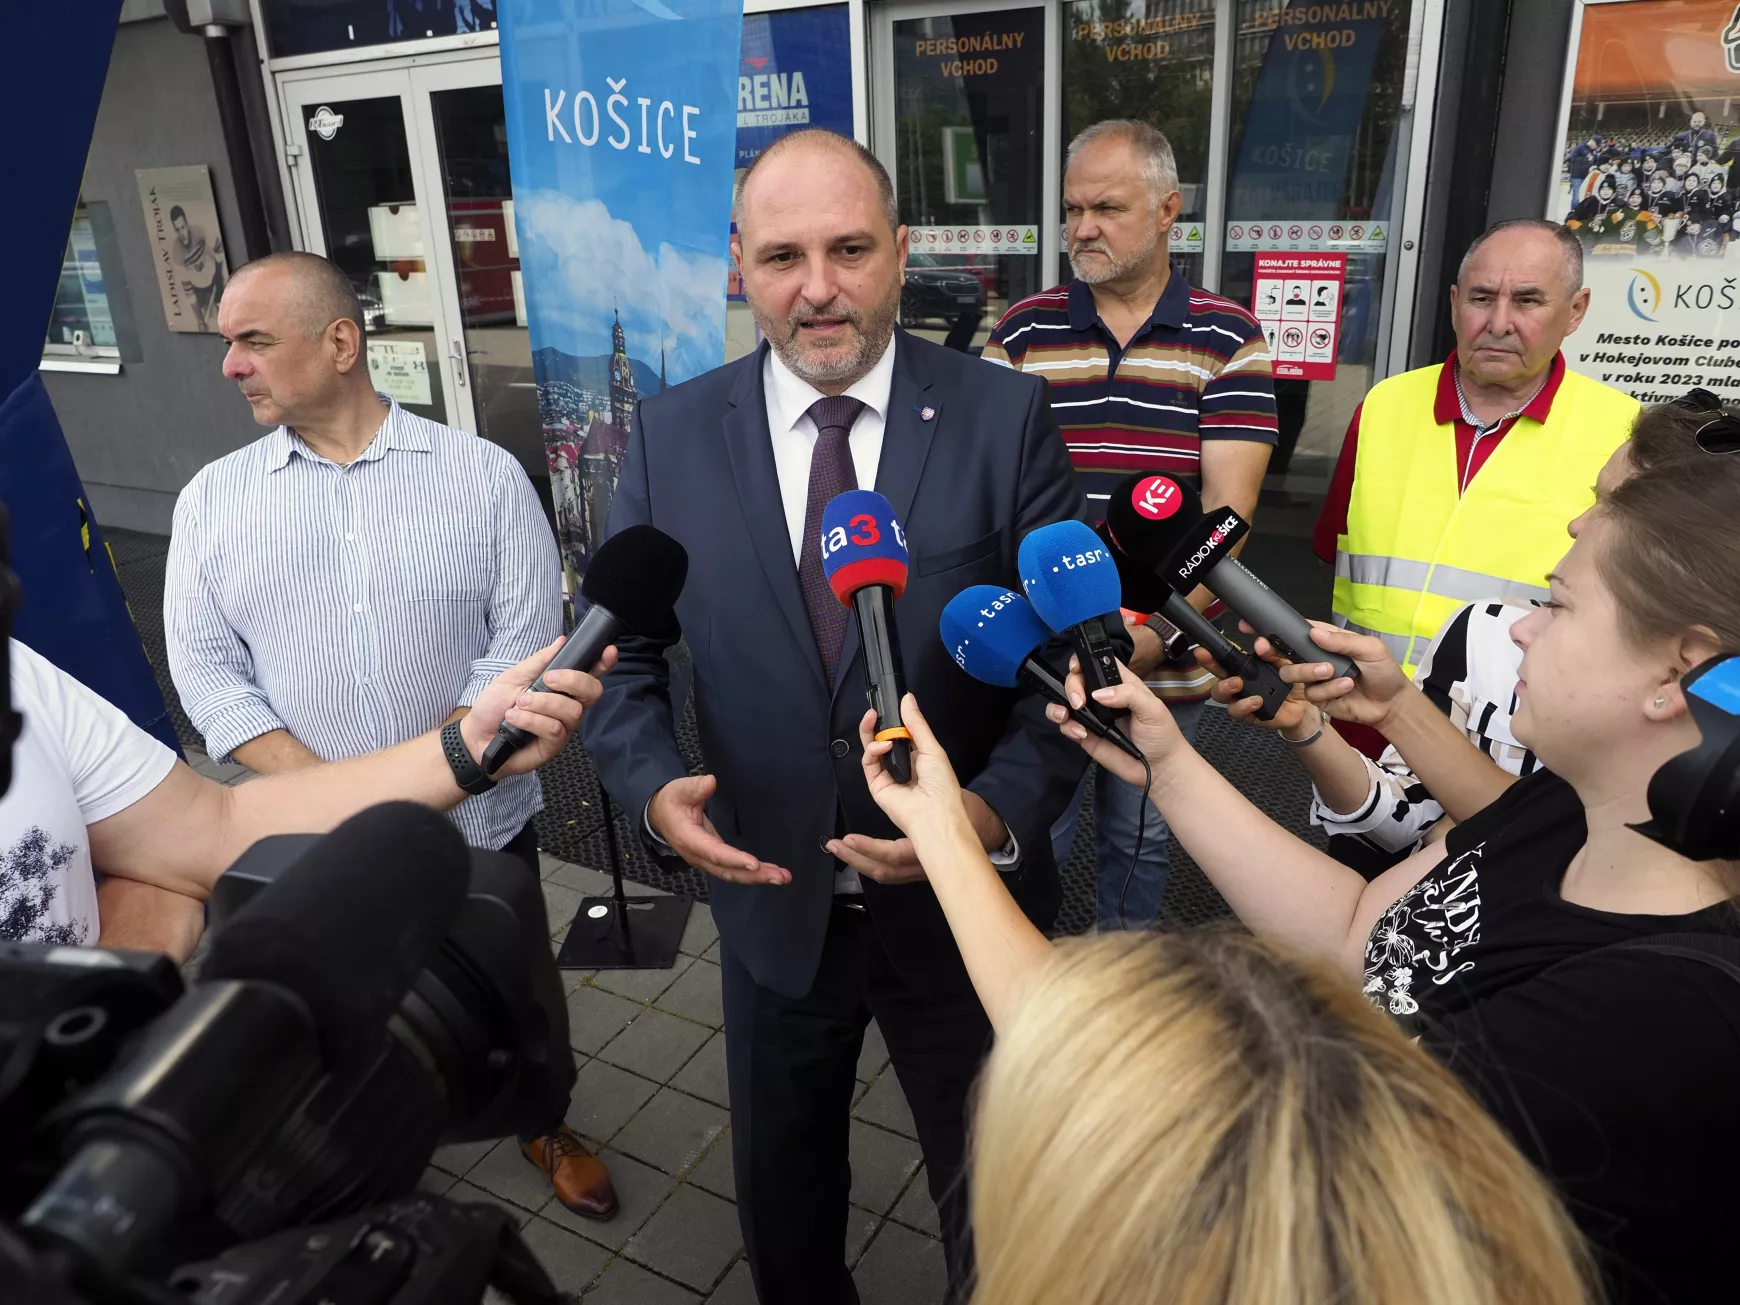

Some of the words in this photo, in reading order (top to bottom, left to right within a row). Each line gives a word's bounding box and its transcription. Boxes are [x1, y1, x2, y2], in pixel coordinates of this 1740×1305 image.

[1077, 13, 1200, 40] PERSONÁLNY
[1254, 0, 1393, 29] PERSONÁLNY
[916, 31, 1025, 56] PERSONÁLNY
[1106, 41, 1170, 62] VCHOD
[1284, 29, 1356, 51] VCHOD
[941, 58, 998, 77] VCHOD
[544, 76, 701, 165] KOŠICE
[1258, 259, 1299, 267] KONAJTE
[1300, 258, 1341, 268] SPRÁVNE
[1674, 277, 1740, 310] KOŠ
[1596, 333, 1651, 345] Mesto
[1655, 334, 1714, 347] Košice
[1580, 353, 1590, 363] v
[1592, 352, 1689, 367] Hokejovom
[1602, 373, 1612, 382] v
[1615, 372, 1656, 384] roku
[1659, 373, 1703, 385] 2023
[1139, 479, 1175, 514] KE
[821, 513, 881, 560] ta3
[1231, 556, 1269, 590] YELLOWTEC
